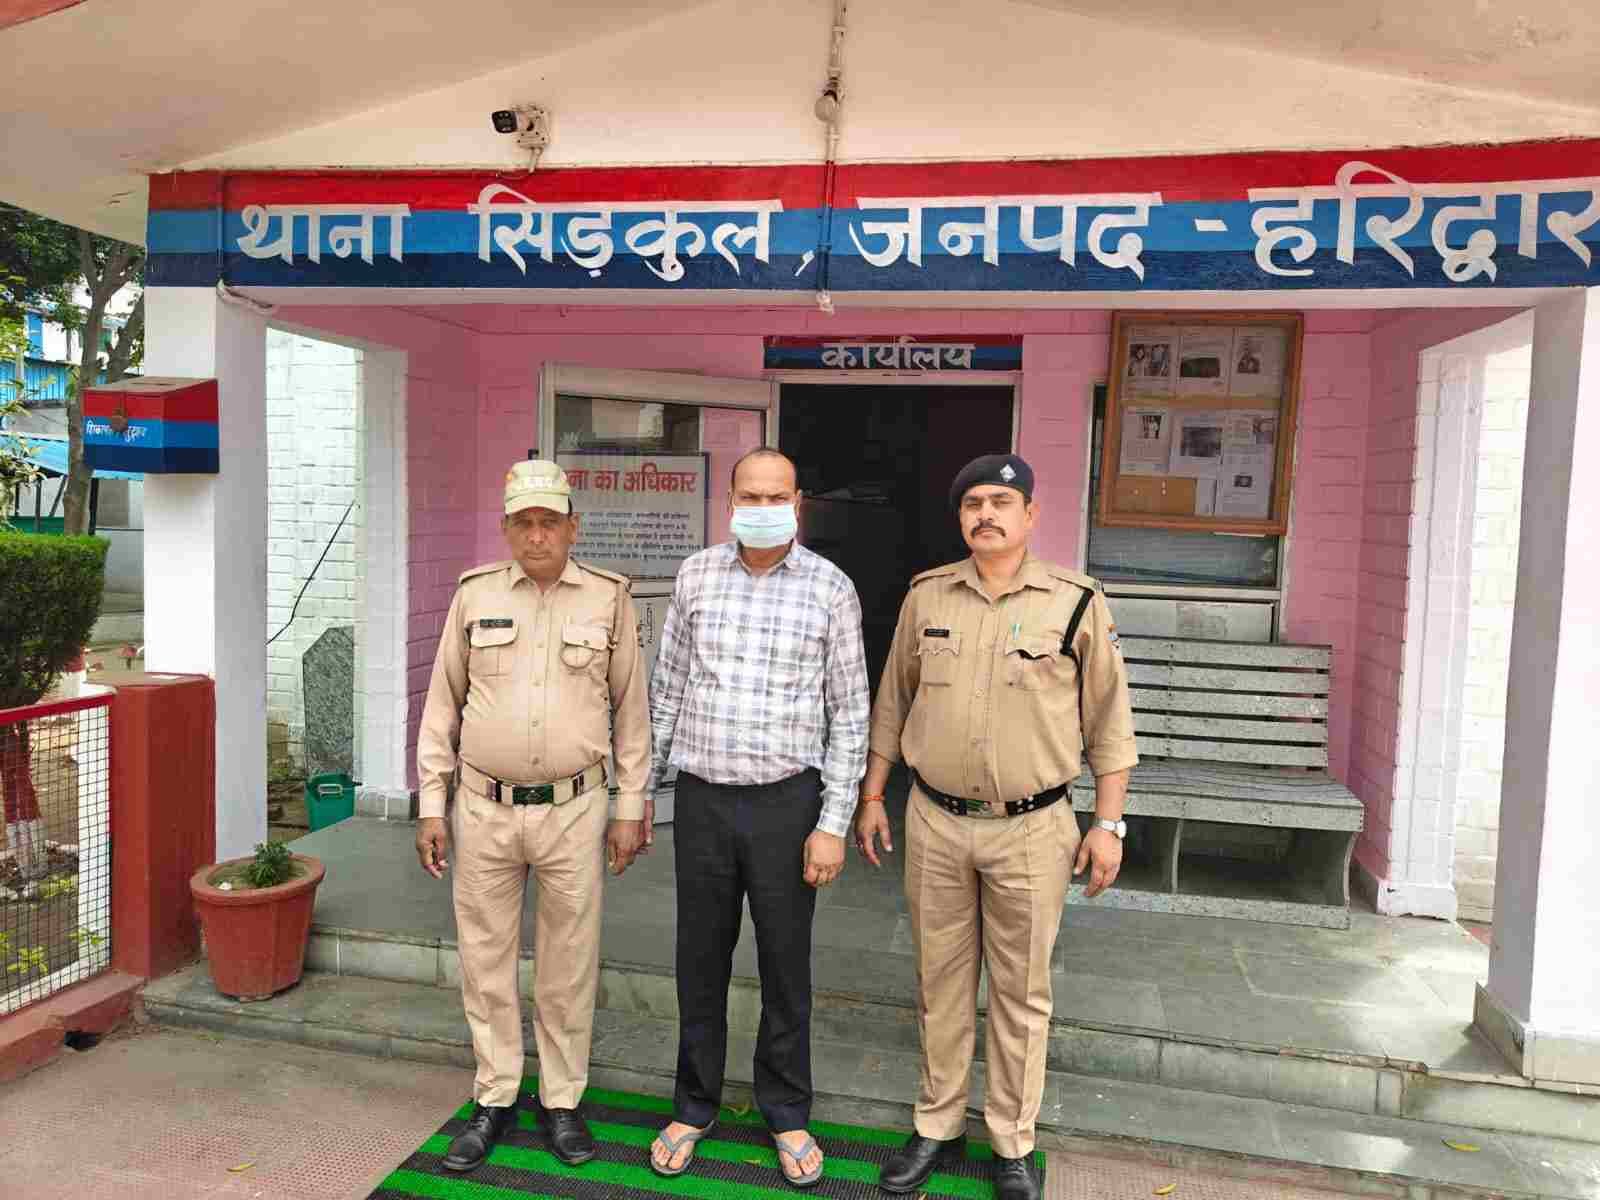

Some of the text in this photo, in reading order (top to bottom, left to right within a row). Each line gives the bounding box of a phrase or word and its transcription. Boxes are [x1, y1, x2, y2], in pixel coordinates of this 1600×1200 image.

[237, 203, 411, 265] थाना
[849, 191, 1163, 282] जनपद
[1247, 160, 1600, 284] हरिद्वार
[821, 335, 976, 370] कार्यालय
[593, 469, 620, 491] का
[623, 462, 698, 494] अधिकार
